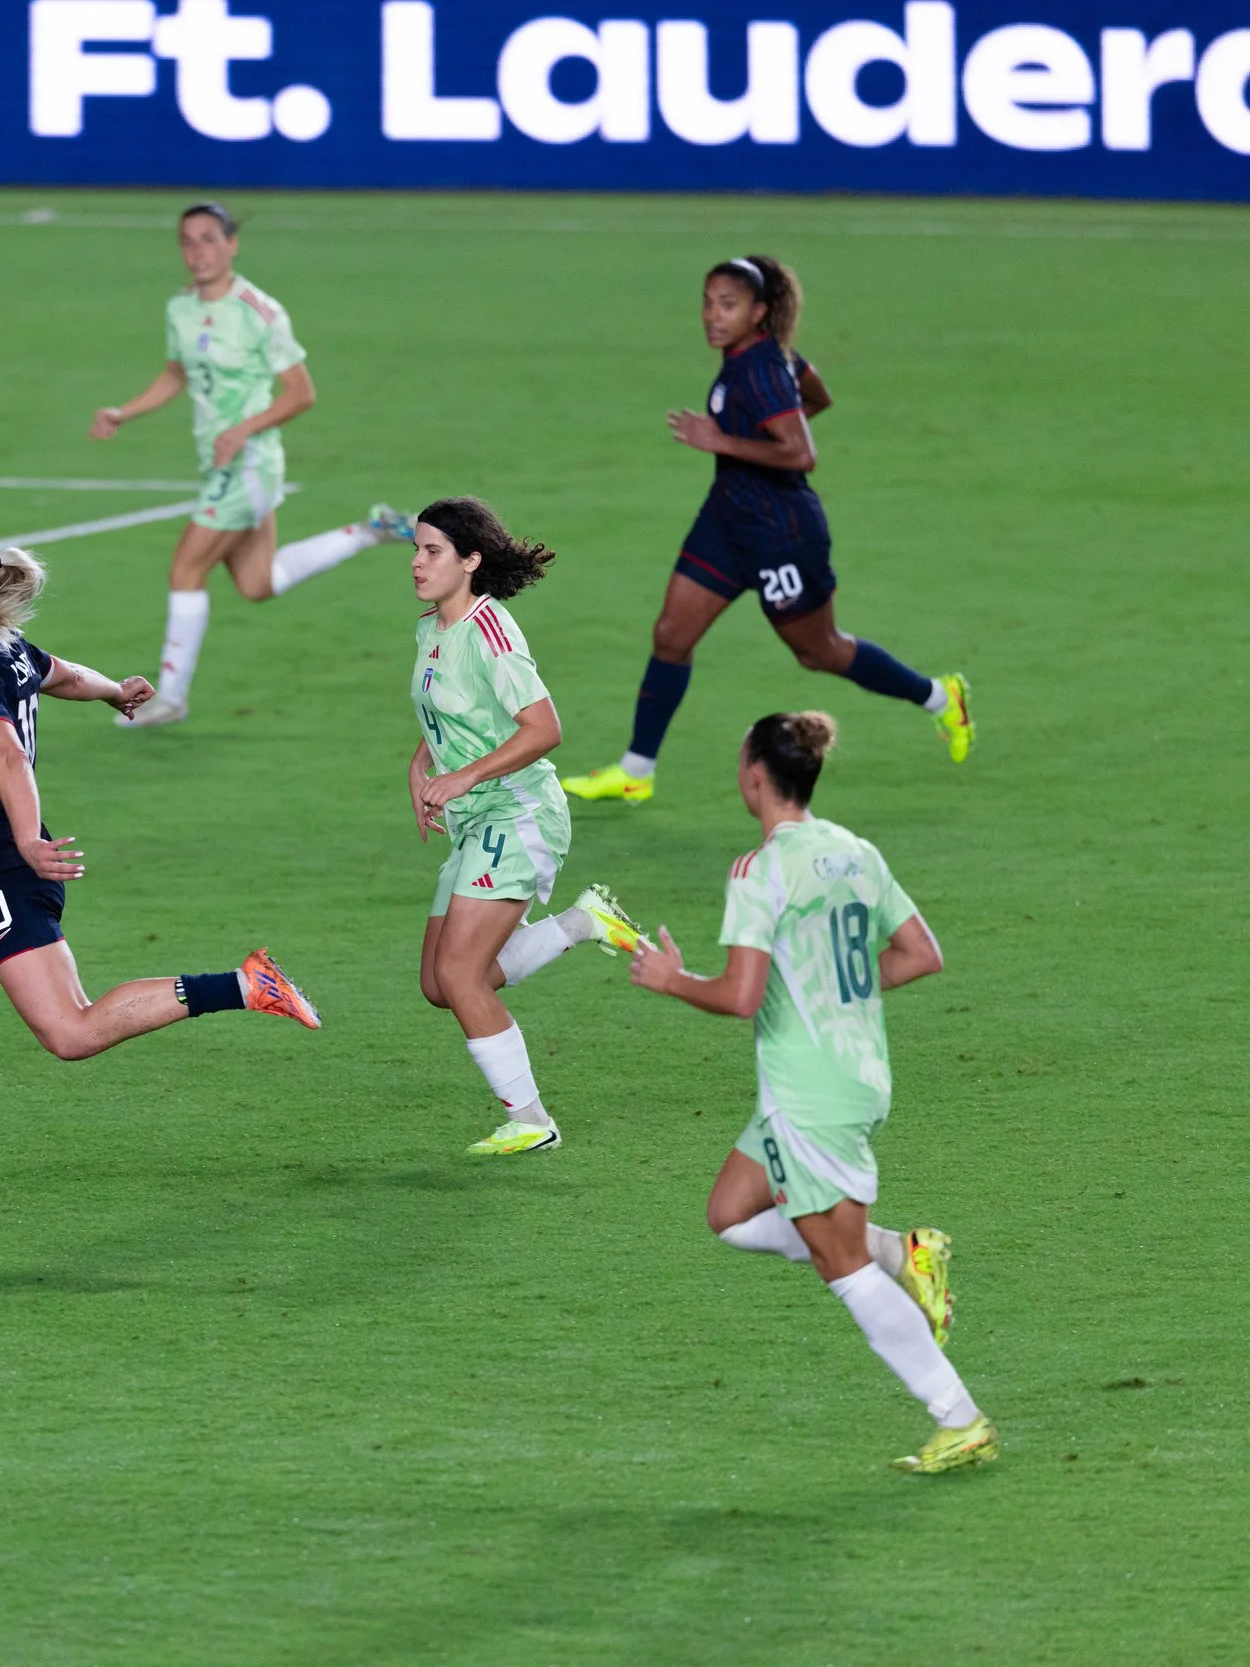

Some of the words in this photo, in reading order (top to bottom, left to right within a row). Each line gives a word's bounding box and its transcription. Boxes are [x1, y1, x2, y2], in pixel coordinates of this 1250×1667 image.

[29, 0, 331, 141] Ft.
[759, 563, 803, 601] 20
[422, 703, 442, 745] 4
[482, 825, 506, 868] 4
[829, 901, 872, 1004] 18
